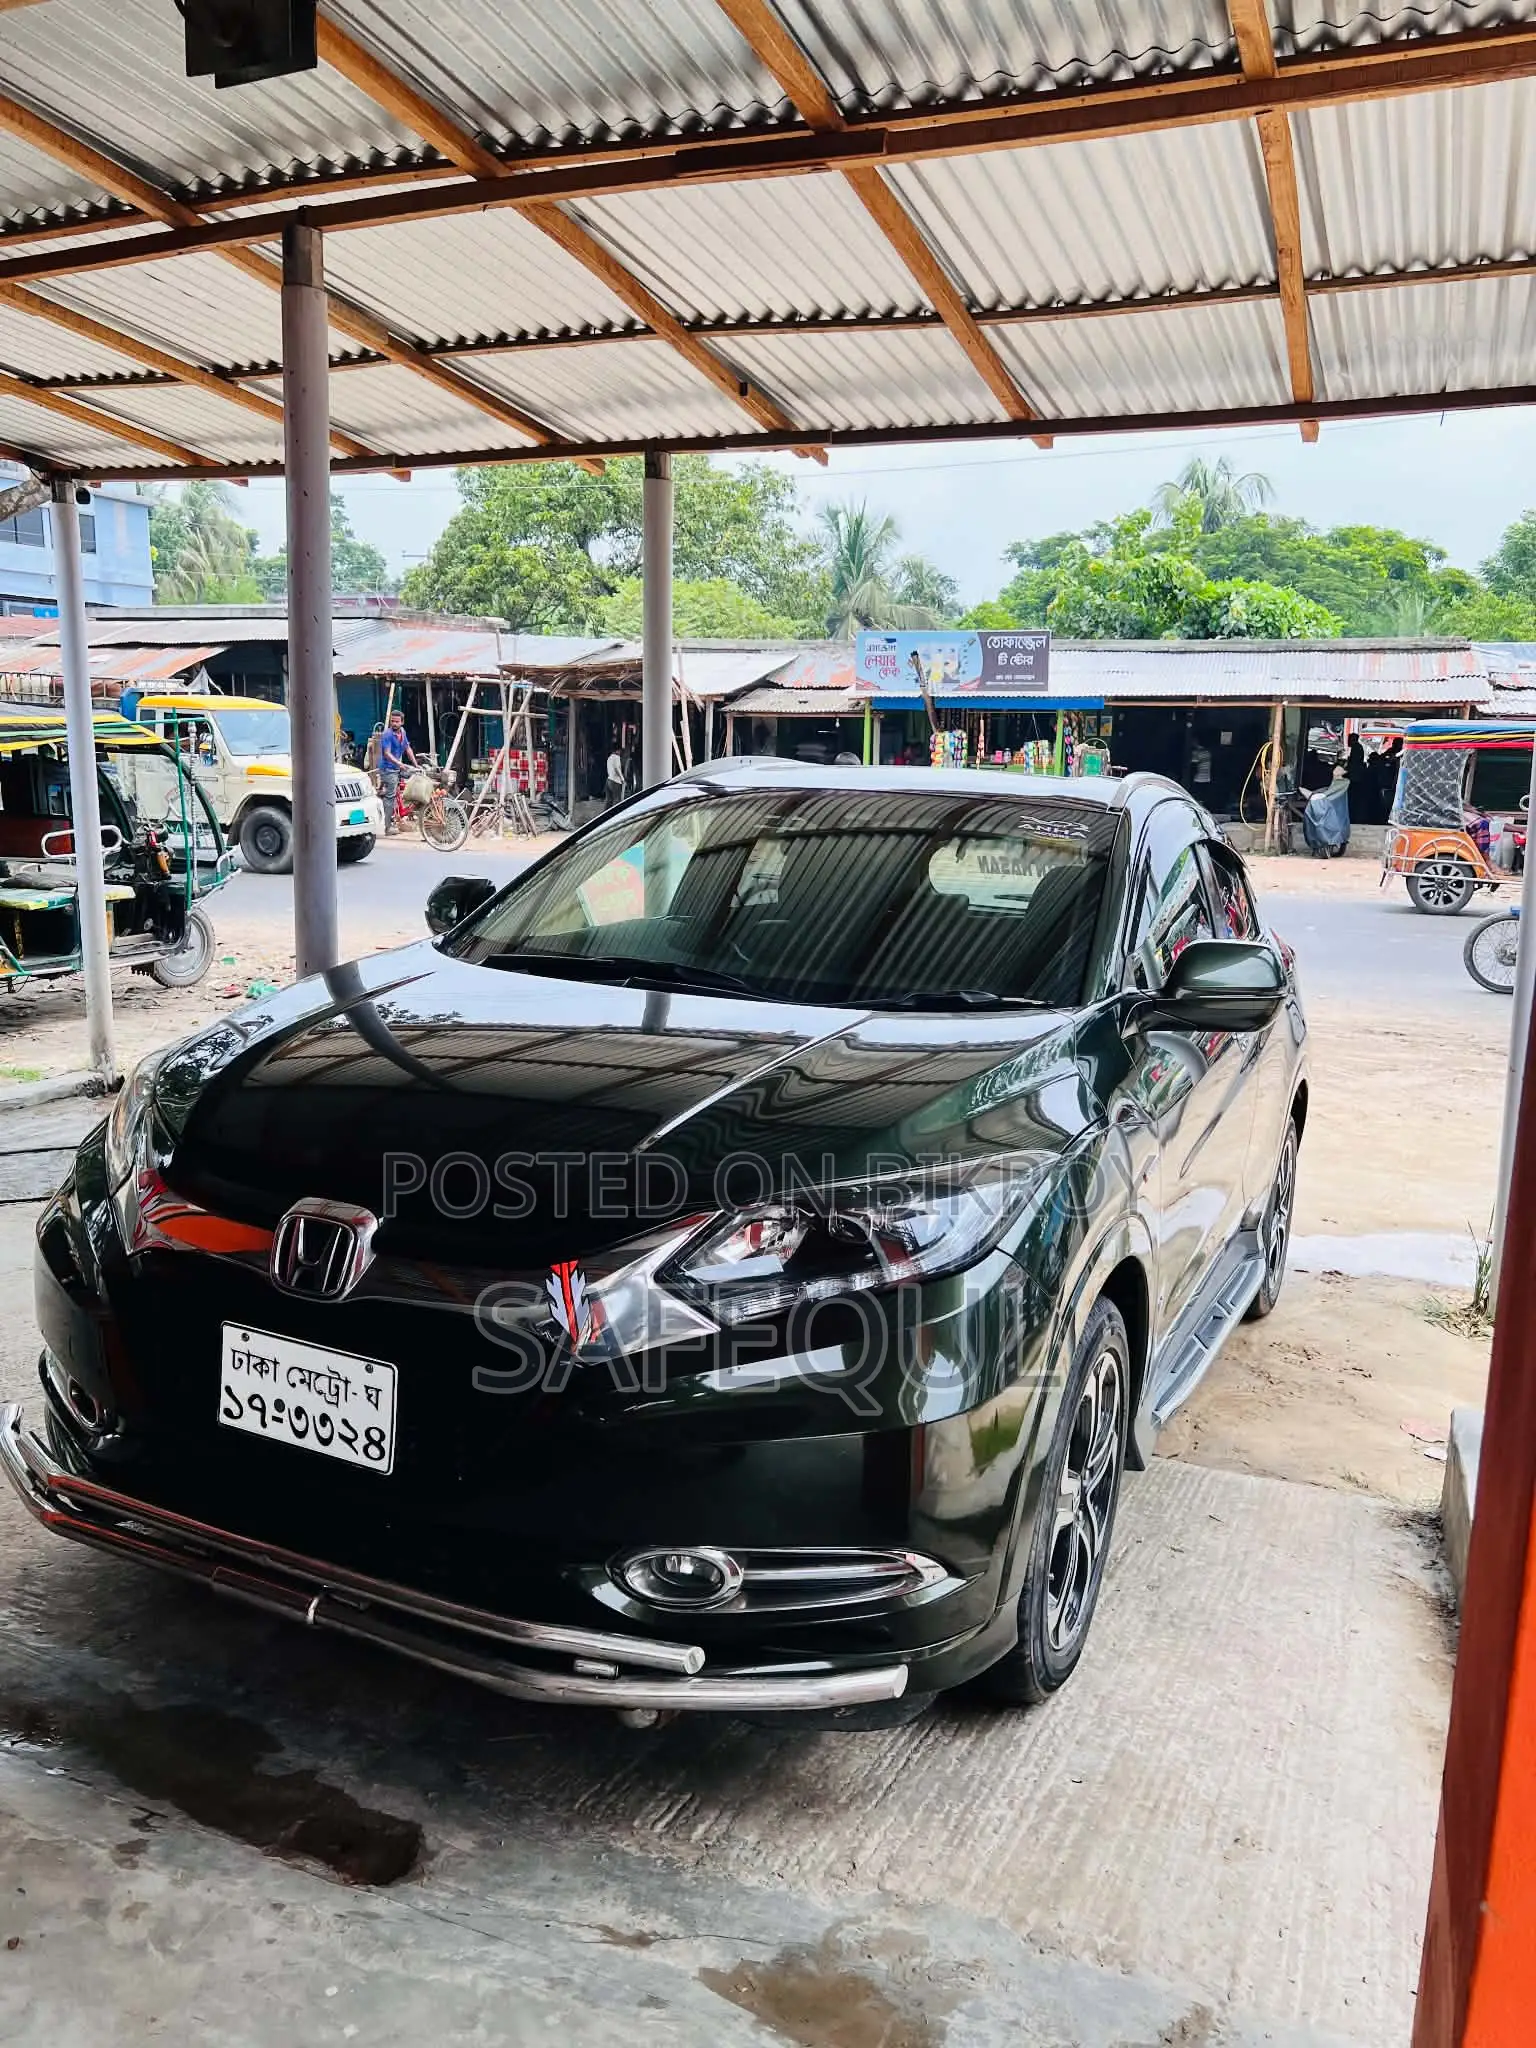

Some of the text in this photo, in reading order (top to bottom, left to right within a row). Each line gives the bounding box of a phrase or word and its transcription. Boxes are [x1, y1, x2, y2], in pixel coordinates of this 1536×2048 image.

[231, 1348, 280, 1383] ঢাকা
[363, 1384, 382, 1411] ঘ
[223, 1385, 387, 1462] ১৭-৩৩২৪
